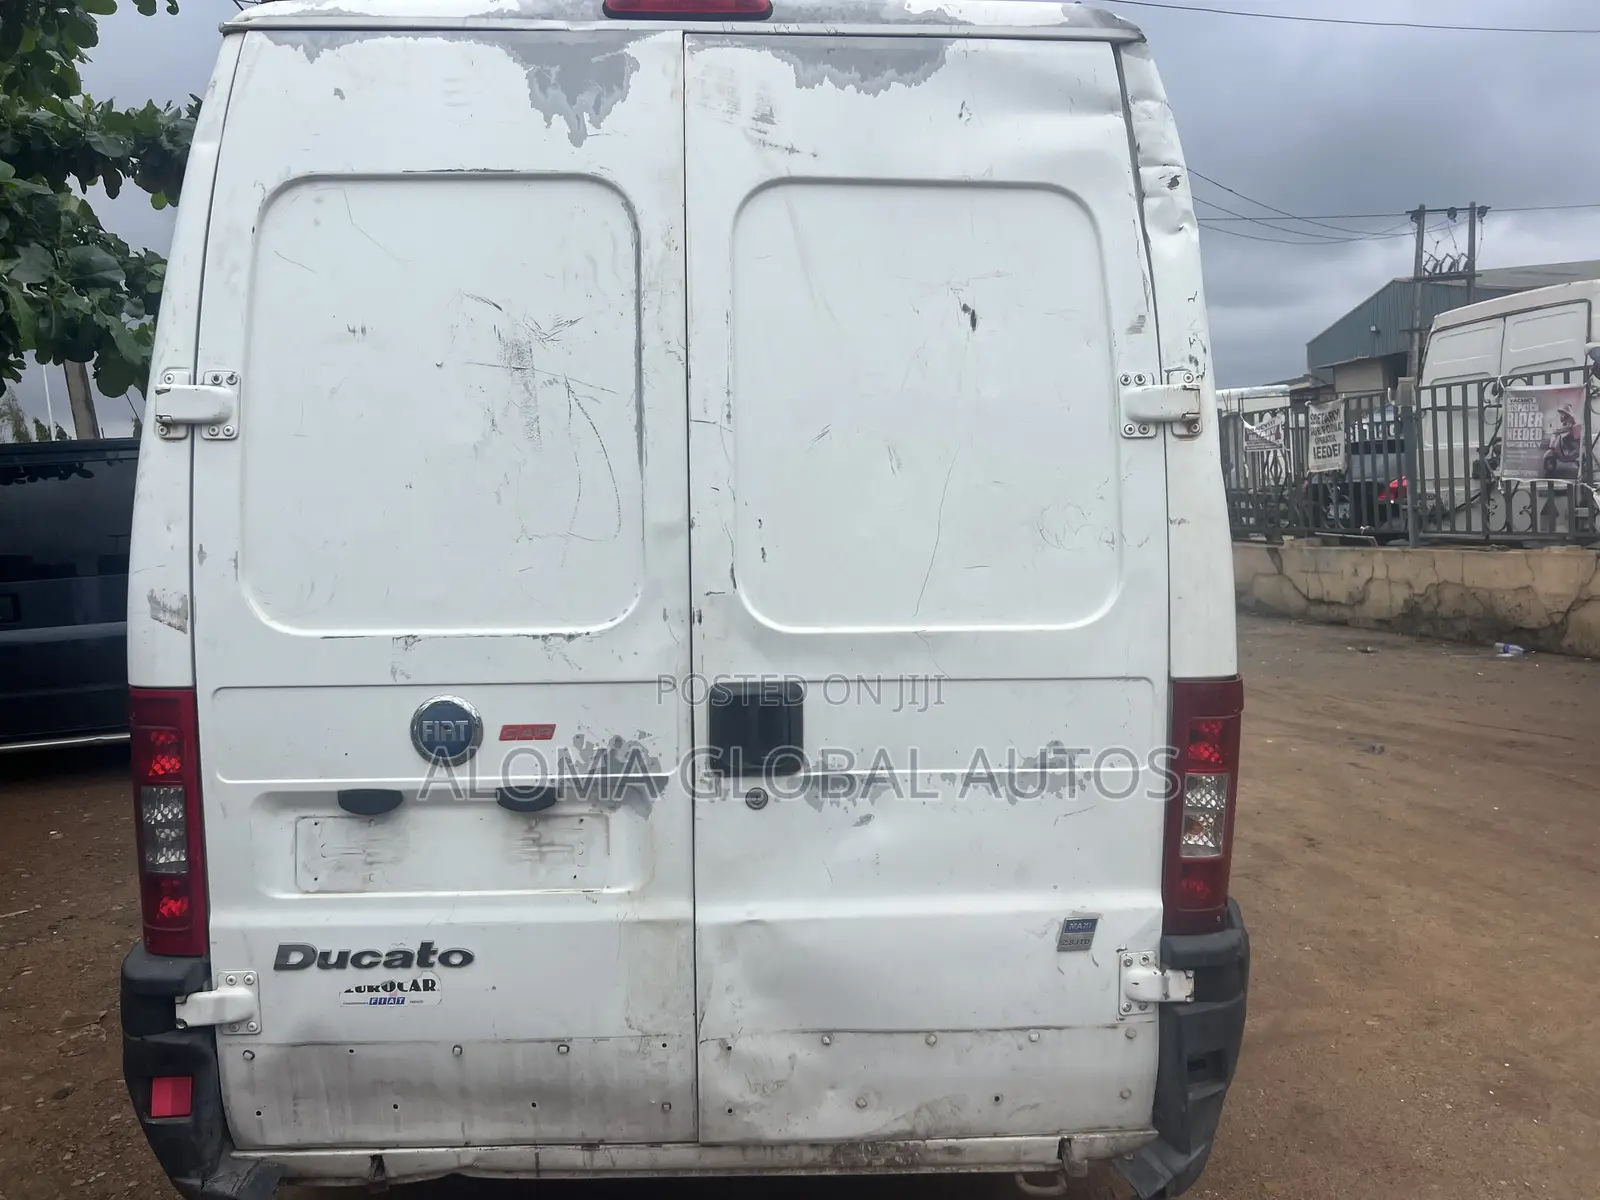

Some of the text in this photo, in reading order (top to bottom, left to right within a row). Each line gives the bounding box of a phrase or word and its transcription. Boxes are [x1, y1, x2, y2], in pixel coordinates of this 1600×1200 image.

[1508, 412, 1543, 427] RIDER
[1508, 428, 1543, 440] NEEDED
[421, 720, 469, 742] FIAT
[273, 940, 474, 970] Ducato
[369, 997, 405, 1005] FIAT
